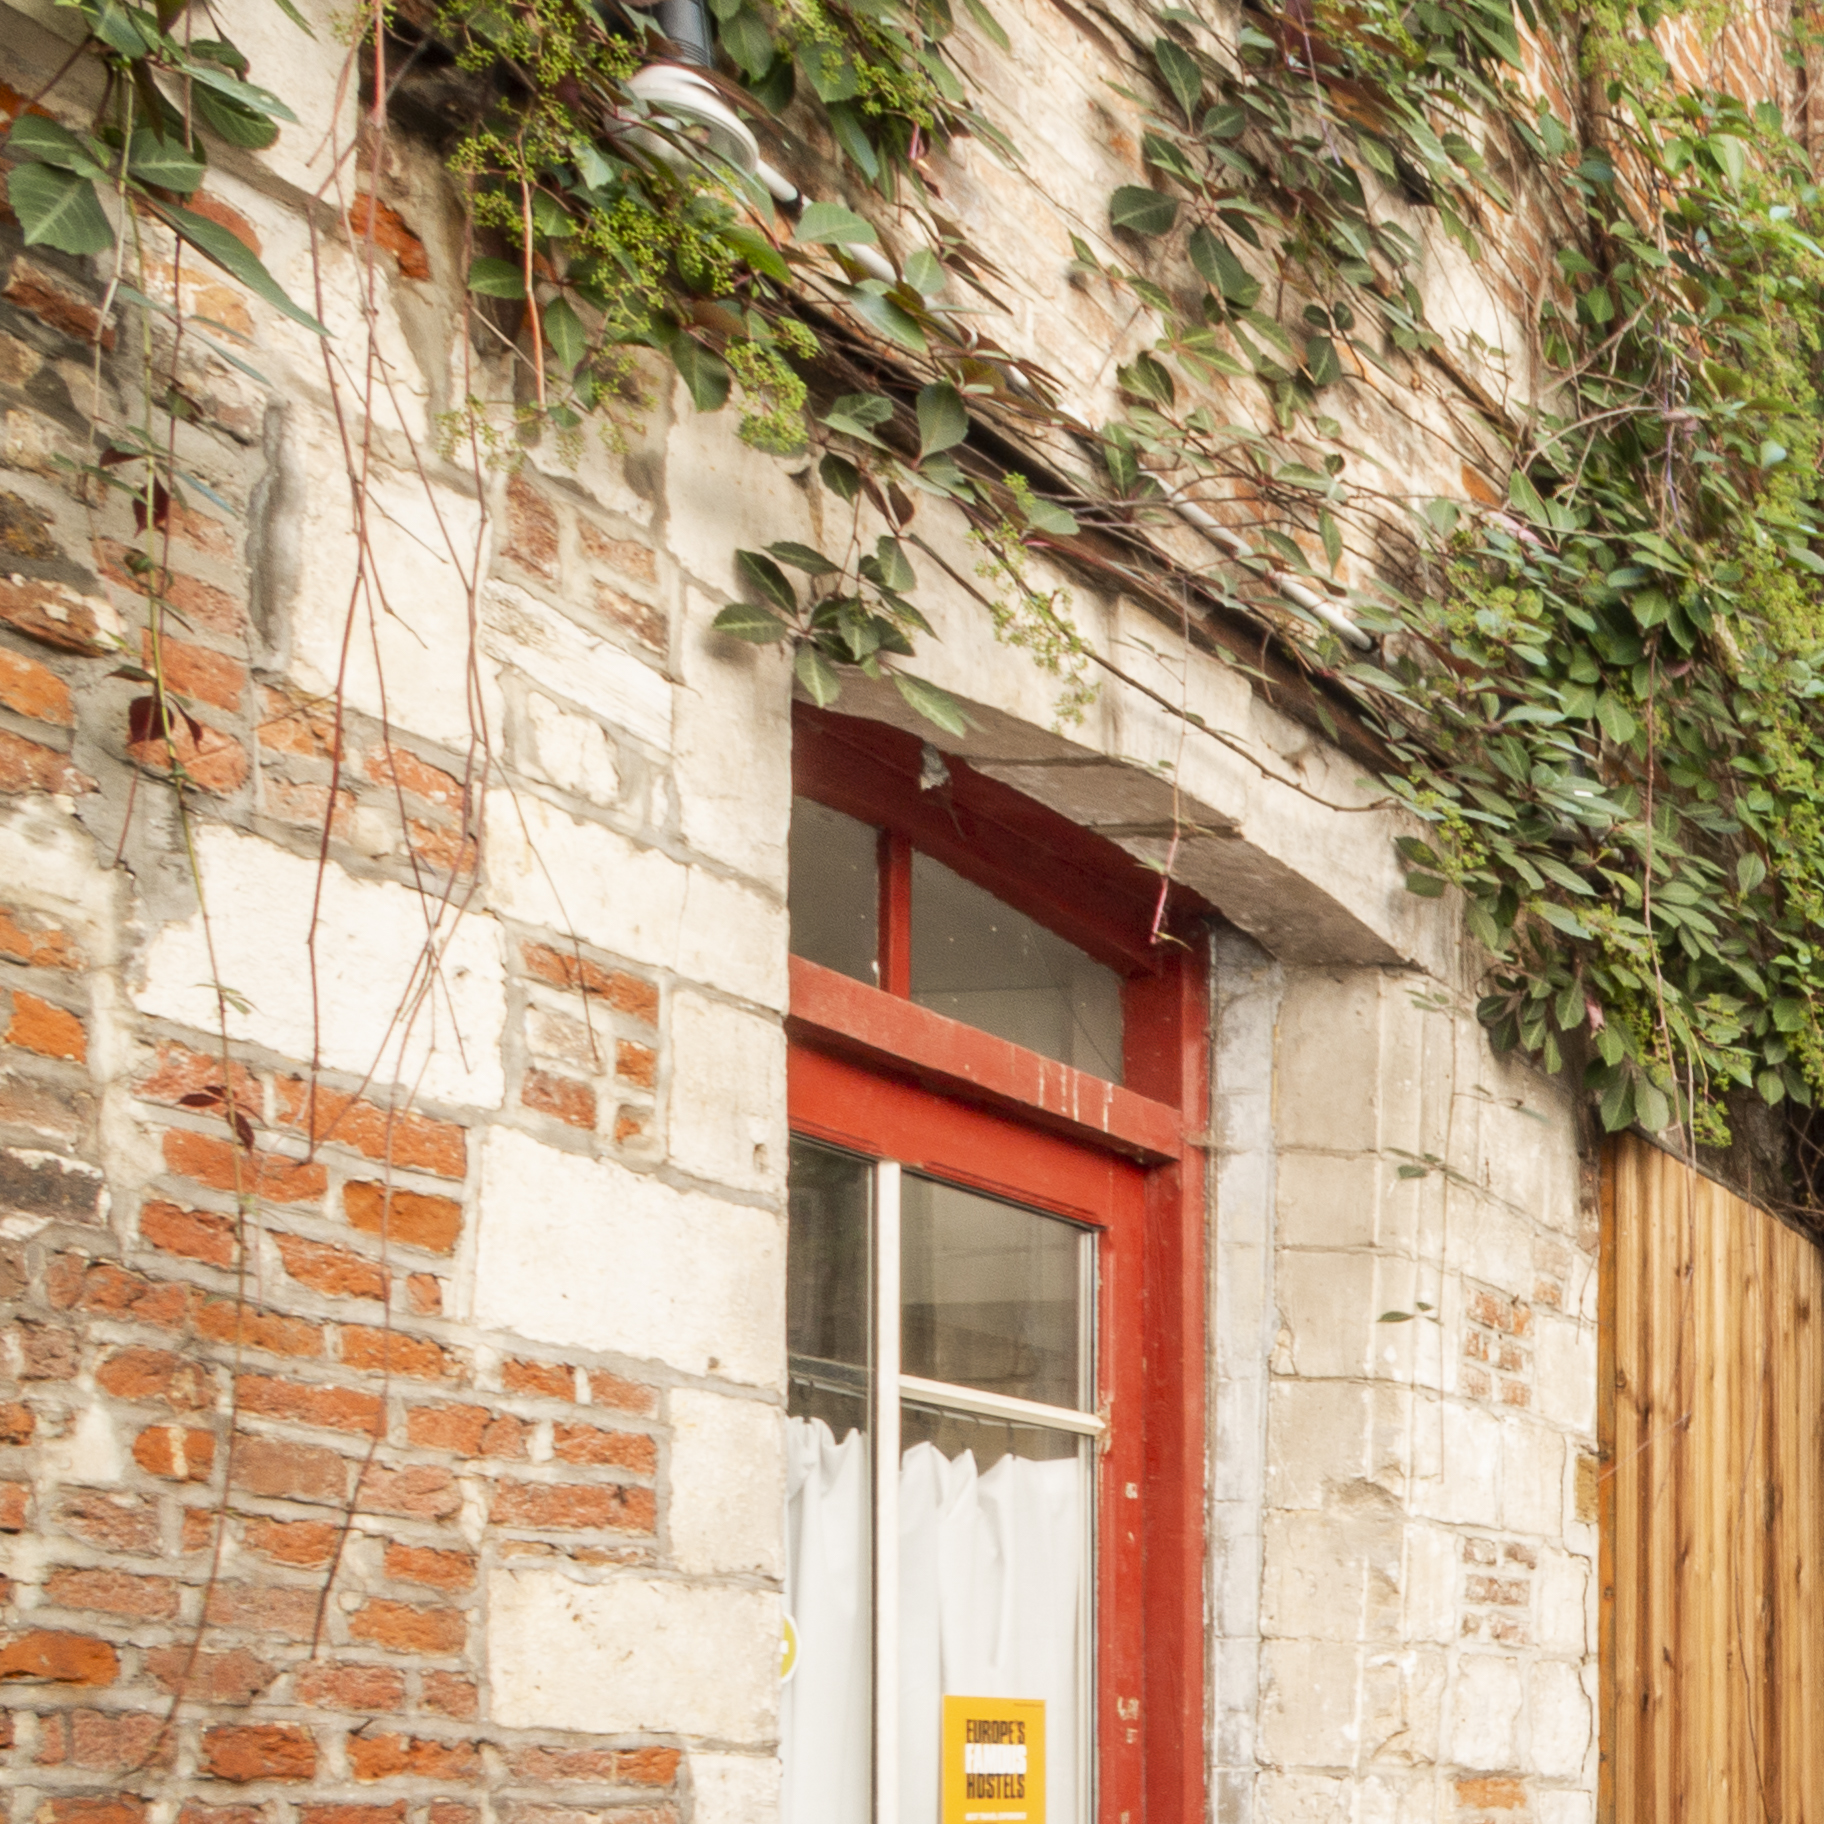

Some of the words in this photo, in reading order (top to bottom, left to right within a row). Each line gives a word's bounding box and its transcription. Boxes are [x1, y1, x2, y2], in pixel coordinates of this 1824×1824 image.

[966, 1719, 1025, 1744] EUROPE'S
[965, 1743, 1027, 1774] FAMOUS
[966, 1773, 1025, 1799] HOSTELS
